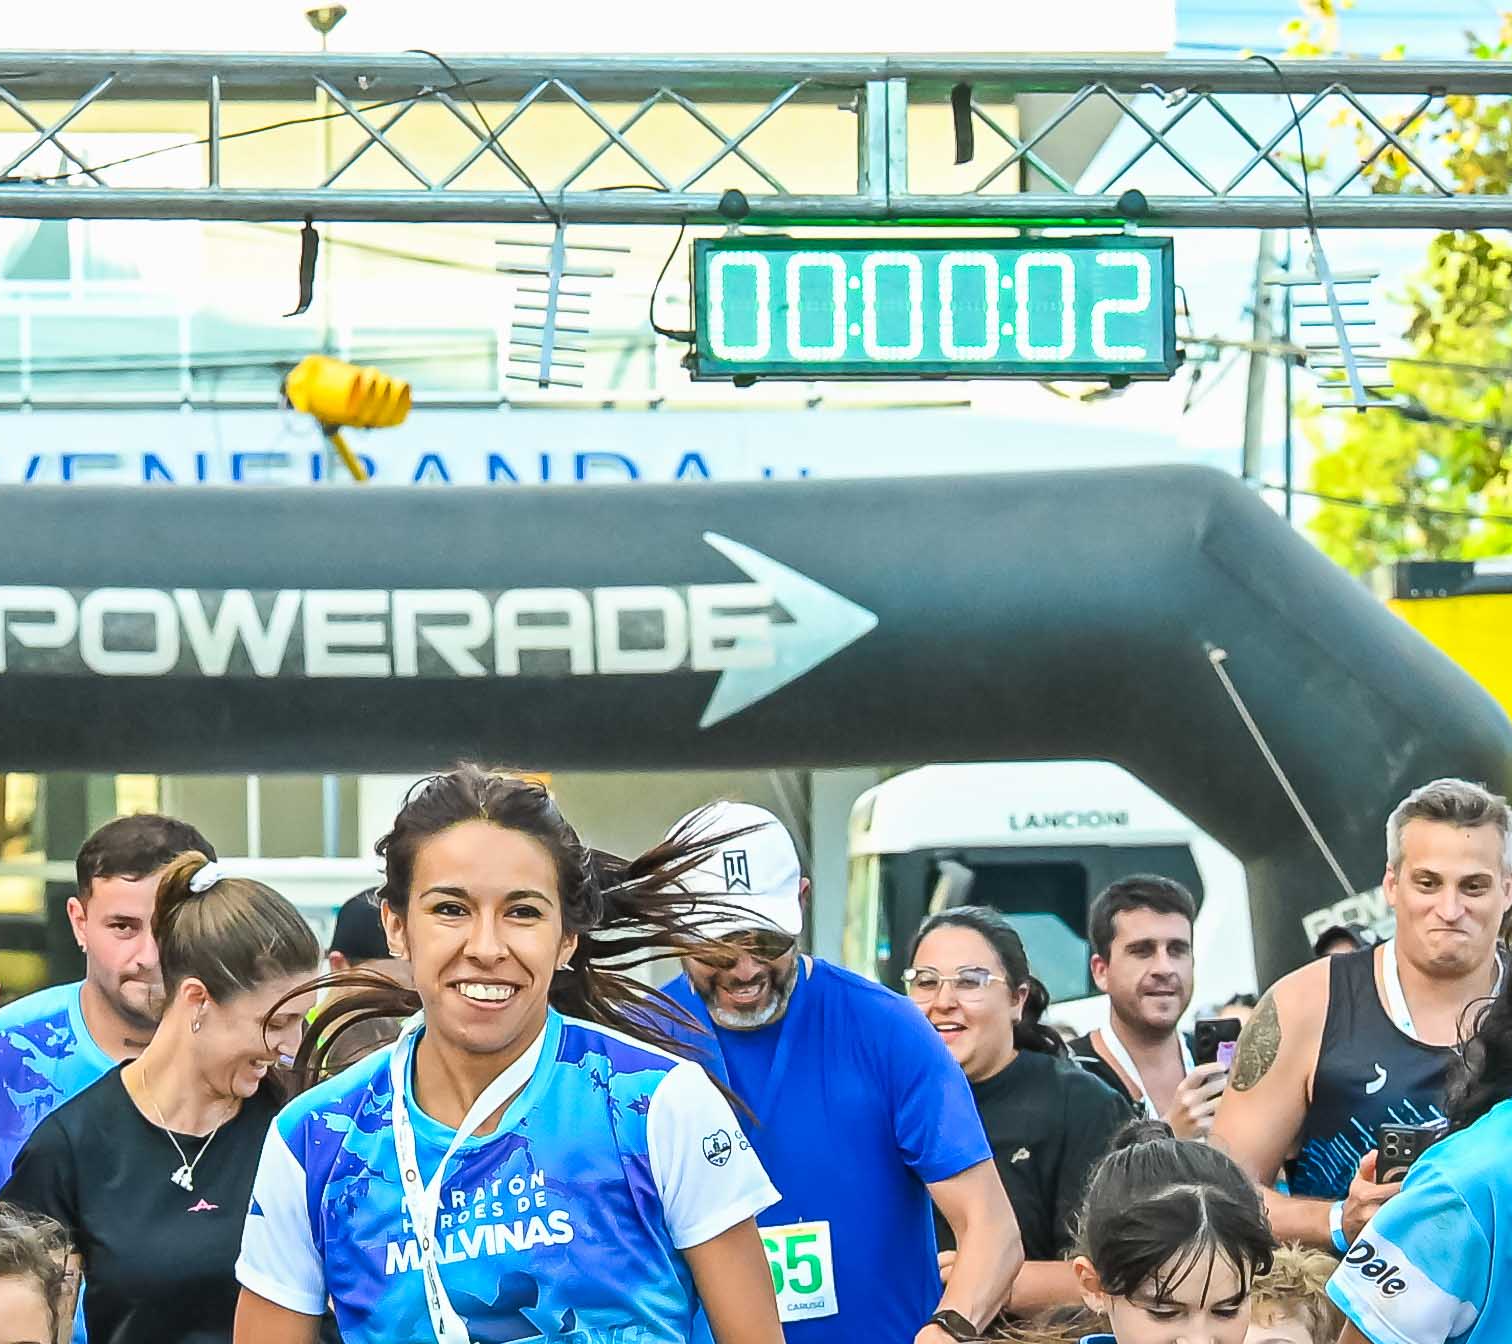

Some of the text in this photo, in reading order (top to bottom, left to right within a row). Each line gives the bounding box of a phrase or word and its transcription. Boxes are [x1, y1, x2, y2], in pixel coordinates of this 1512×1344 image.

[709, 251, 1152, 360] 00:00:02
[517, 1191, 547, 1213] DE
[1345, 1239, 1407, 1297] Dale
